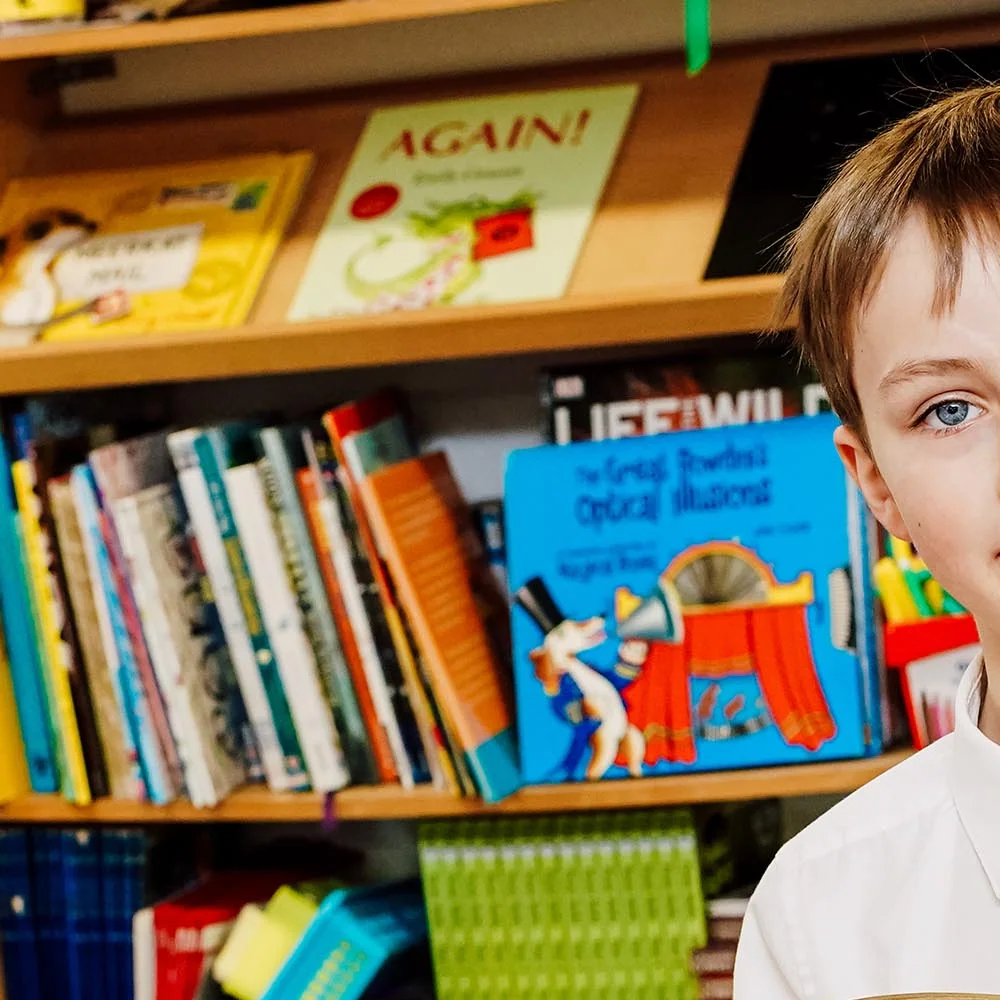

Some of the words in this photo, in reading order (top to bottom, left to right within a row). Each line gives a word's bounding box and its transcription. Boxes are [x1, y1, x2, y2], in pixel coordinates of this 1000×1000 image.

[376, 108, 592, 164] AGAIN!
[554, 396, 681, 446] LIFE
[577, 488, 658, 529] Optical
